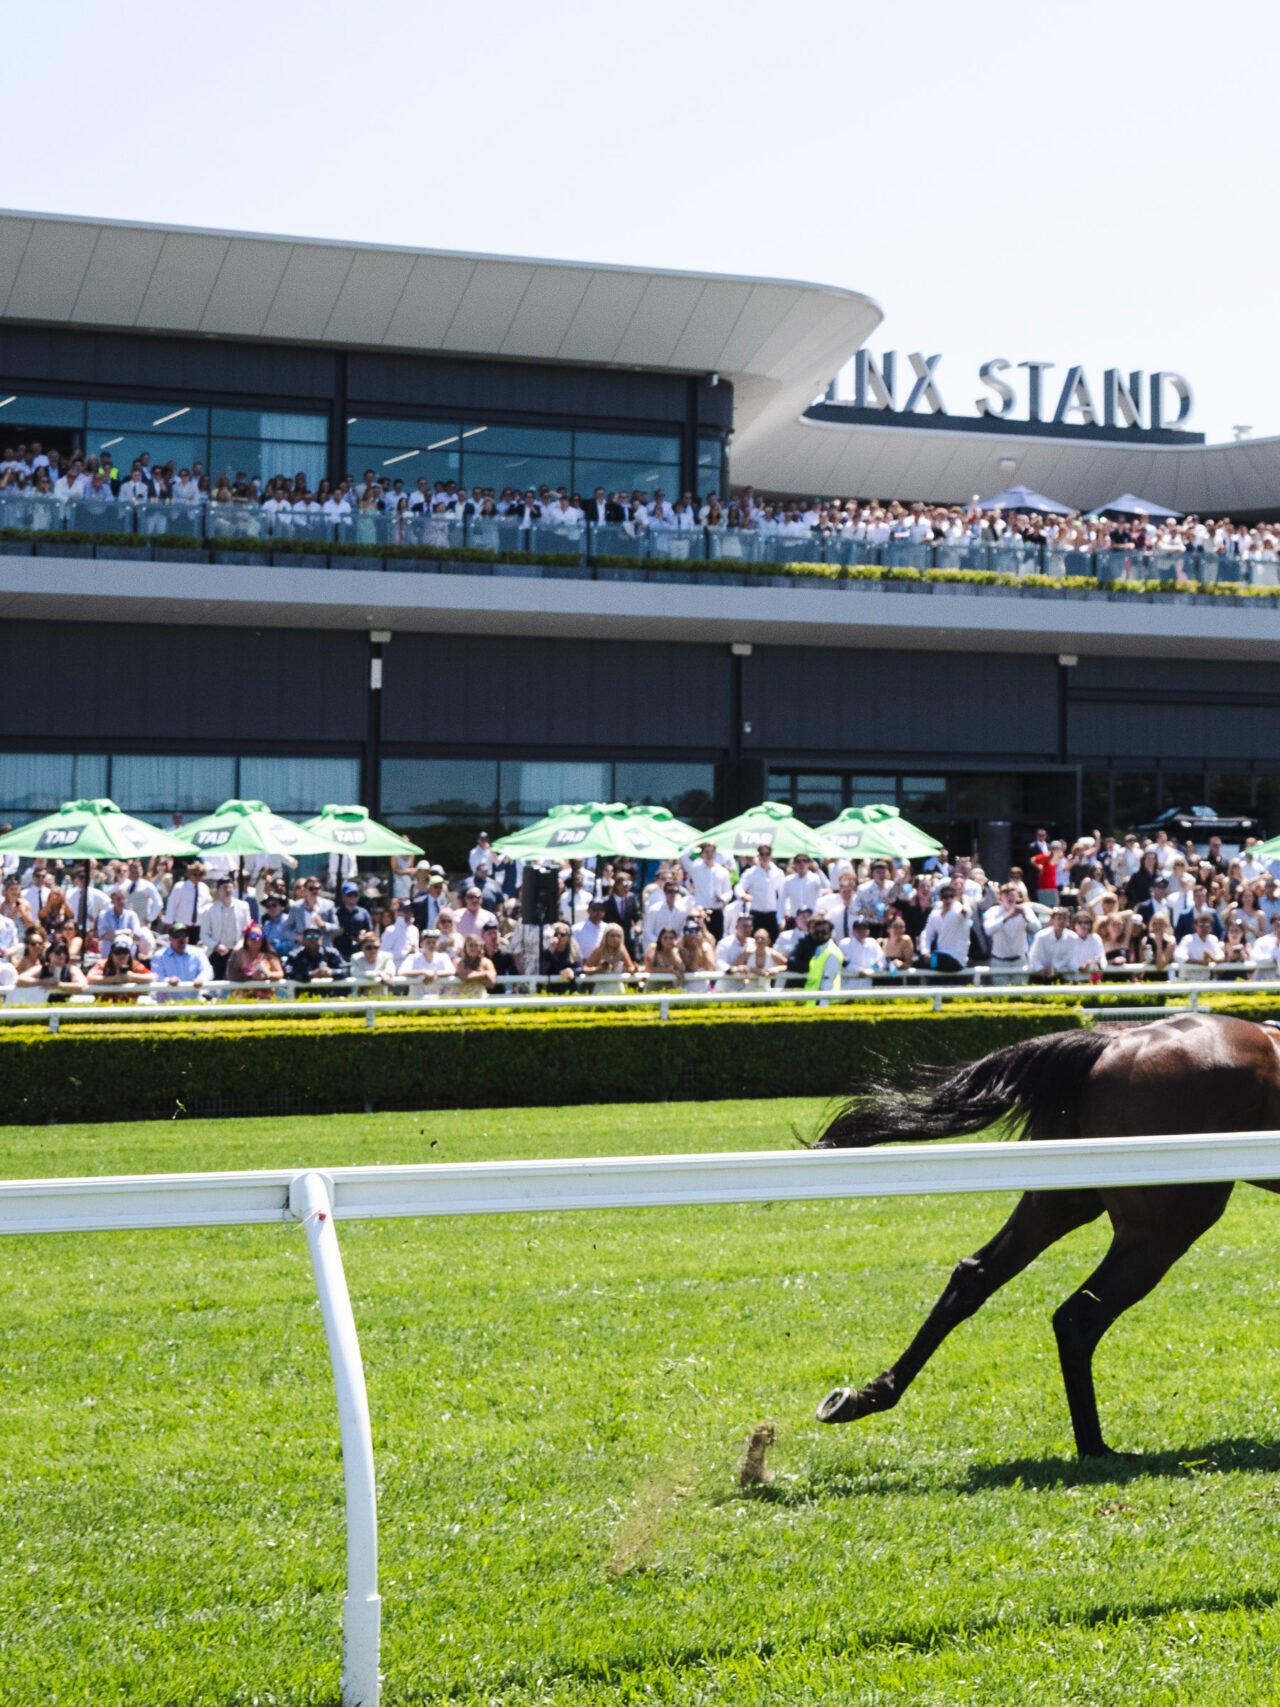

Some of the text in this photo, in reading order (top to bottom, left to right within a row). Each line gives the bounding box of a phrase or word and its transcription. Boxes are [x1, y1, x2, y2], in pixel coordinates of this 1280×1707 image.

[976, 358, 1194, 432] STAND
[45, 830, 79, 844] TAB
[197, 831, 230, 845] TAB
[334, 831, 366, 842] TAB
[556, 830, 586, 843] TAB
[740, 831, 773, 845] TAB
